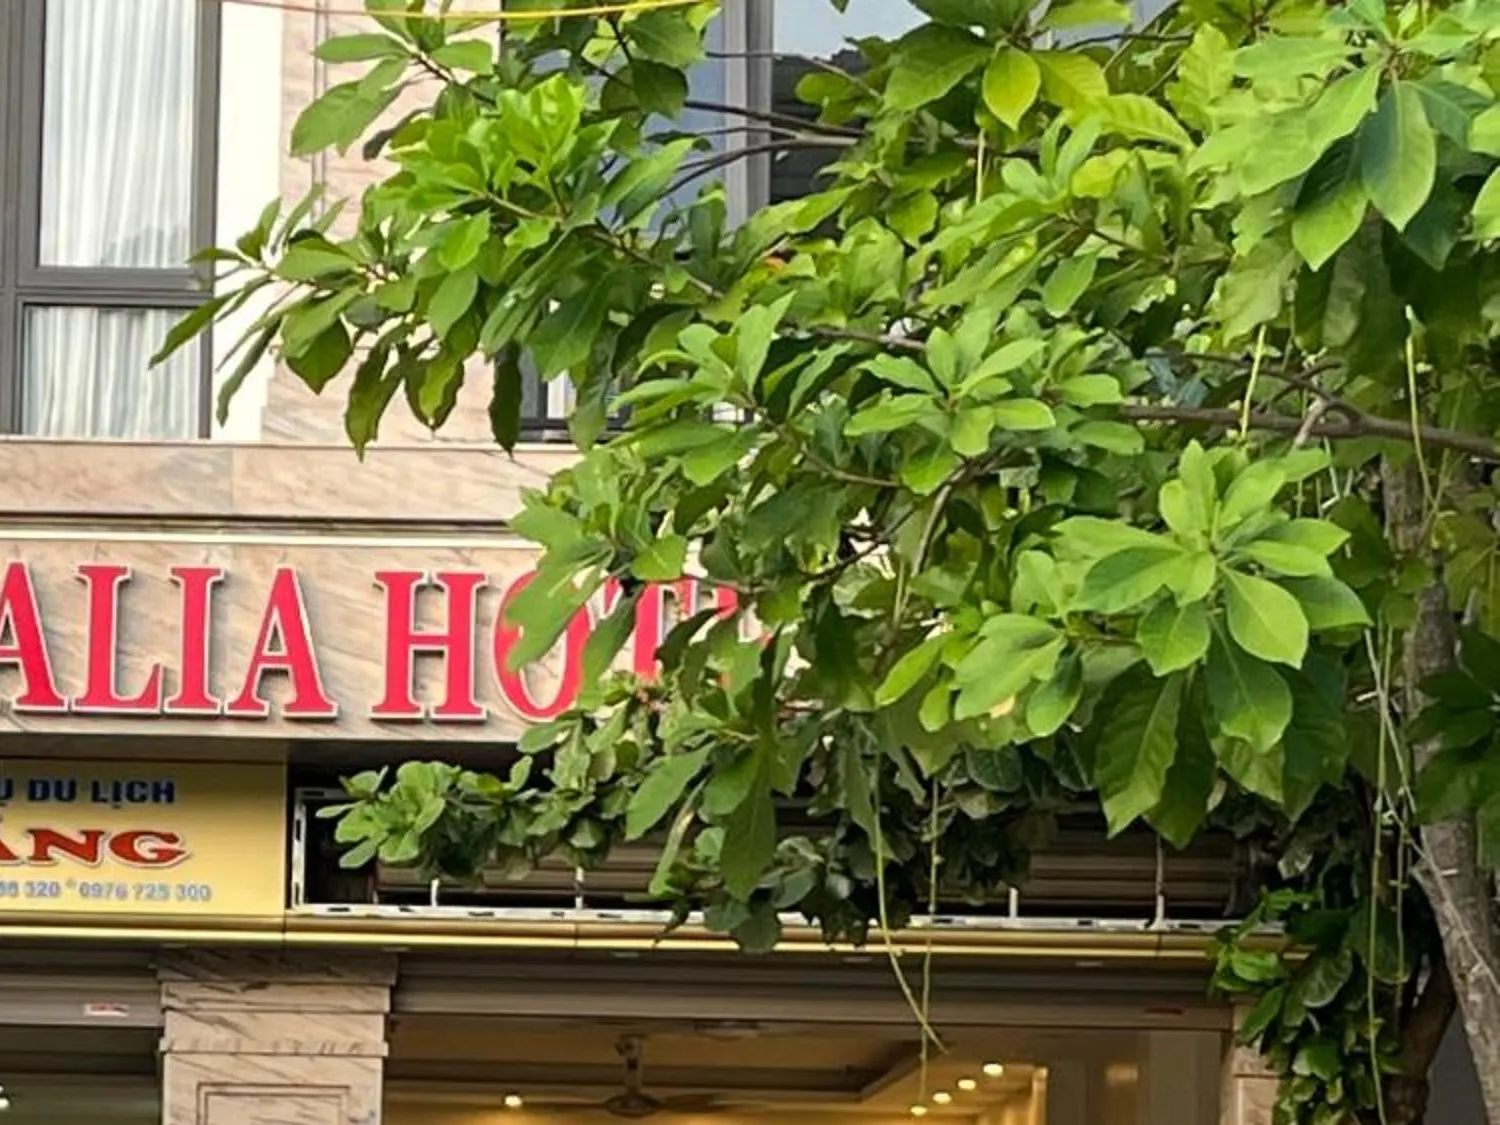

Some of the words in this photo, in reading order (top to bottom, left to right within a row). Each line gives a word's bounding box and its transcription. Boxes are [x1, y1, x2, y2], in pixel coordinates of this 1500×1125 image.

[370, 564, 772, 724] HOT
[27, 779, 77, 802] DU
[90, 779, 176, 808] LỊCH
